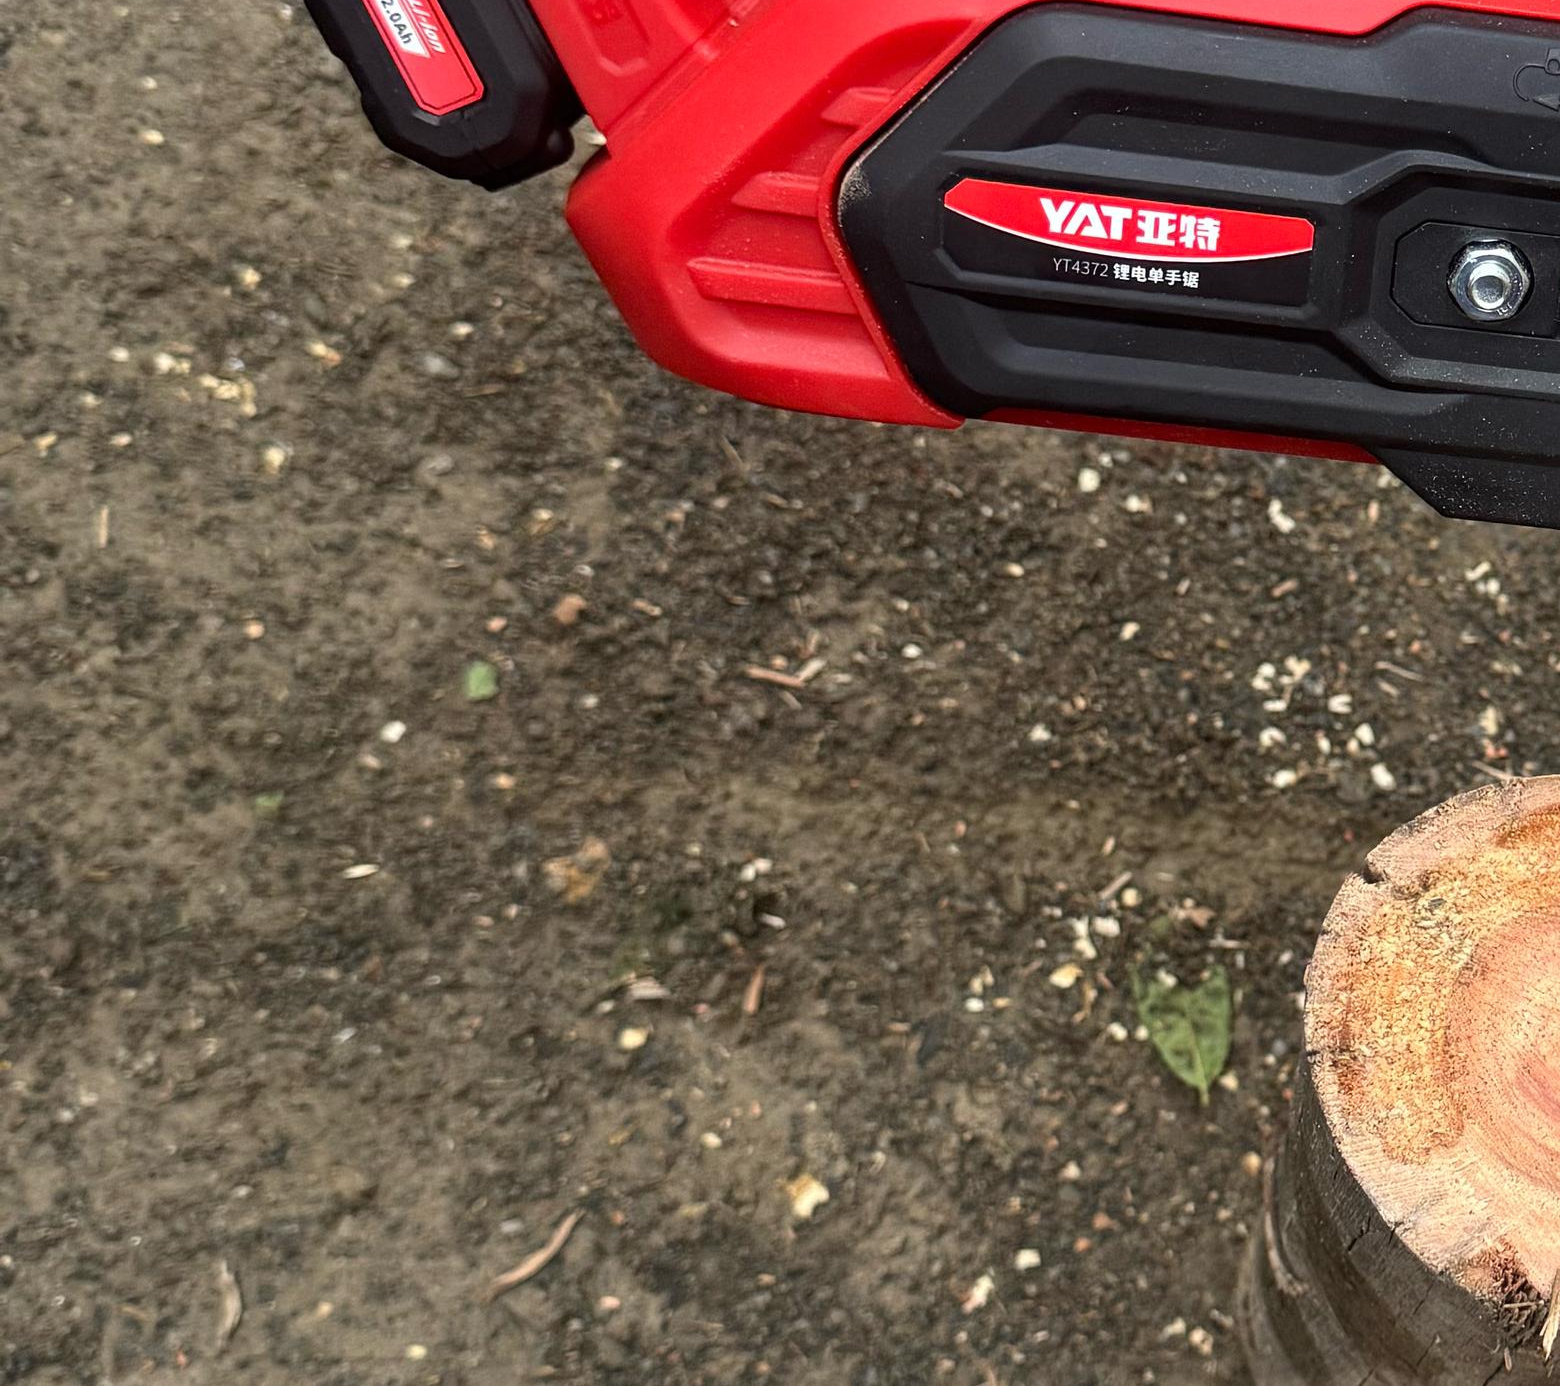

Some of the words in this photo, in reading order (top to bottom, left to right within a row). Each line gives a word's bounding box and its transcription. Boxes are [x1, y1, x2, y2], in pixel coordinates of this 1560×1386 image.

[1039, 197, 1133, 240] YAT
[1135, 209, 1221, 252] 亚特
[1053, 257, 1109, 278] YT4372
[1113, 263, 1200, 289] 锂电单手锯
